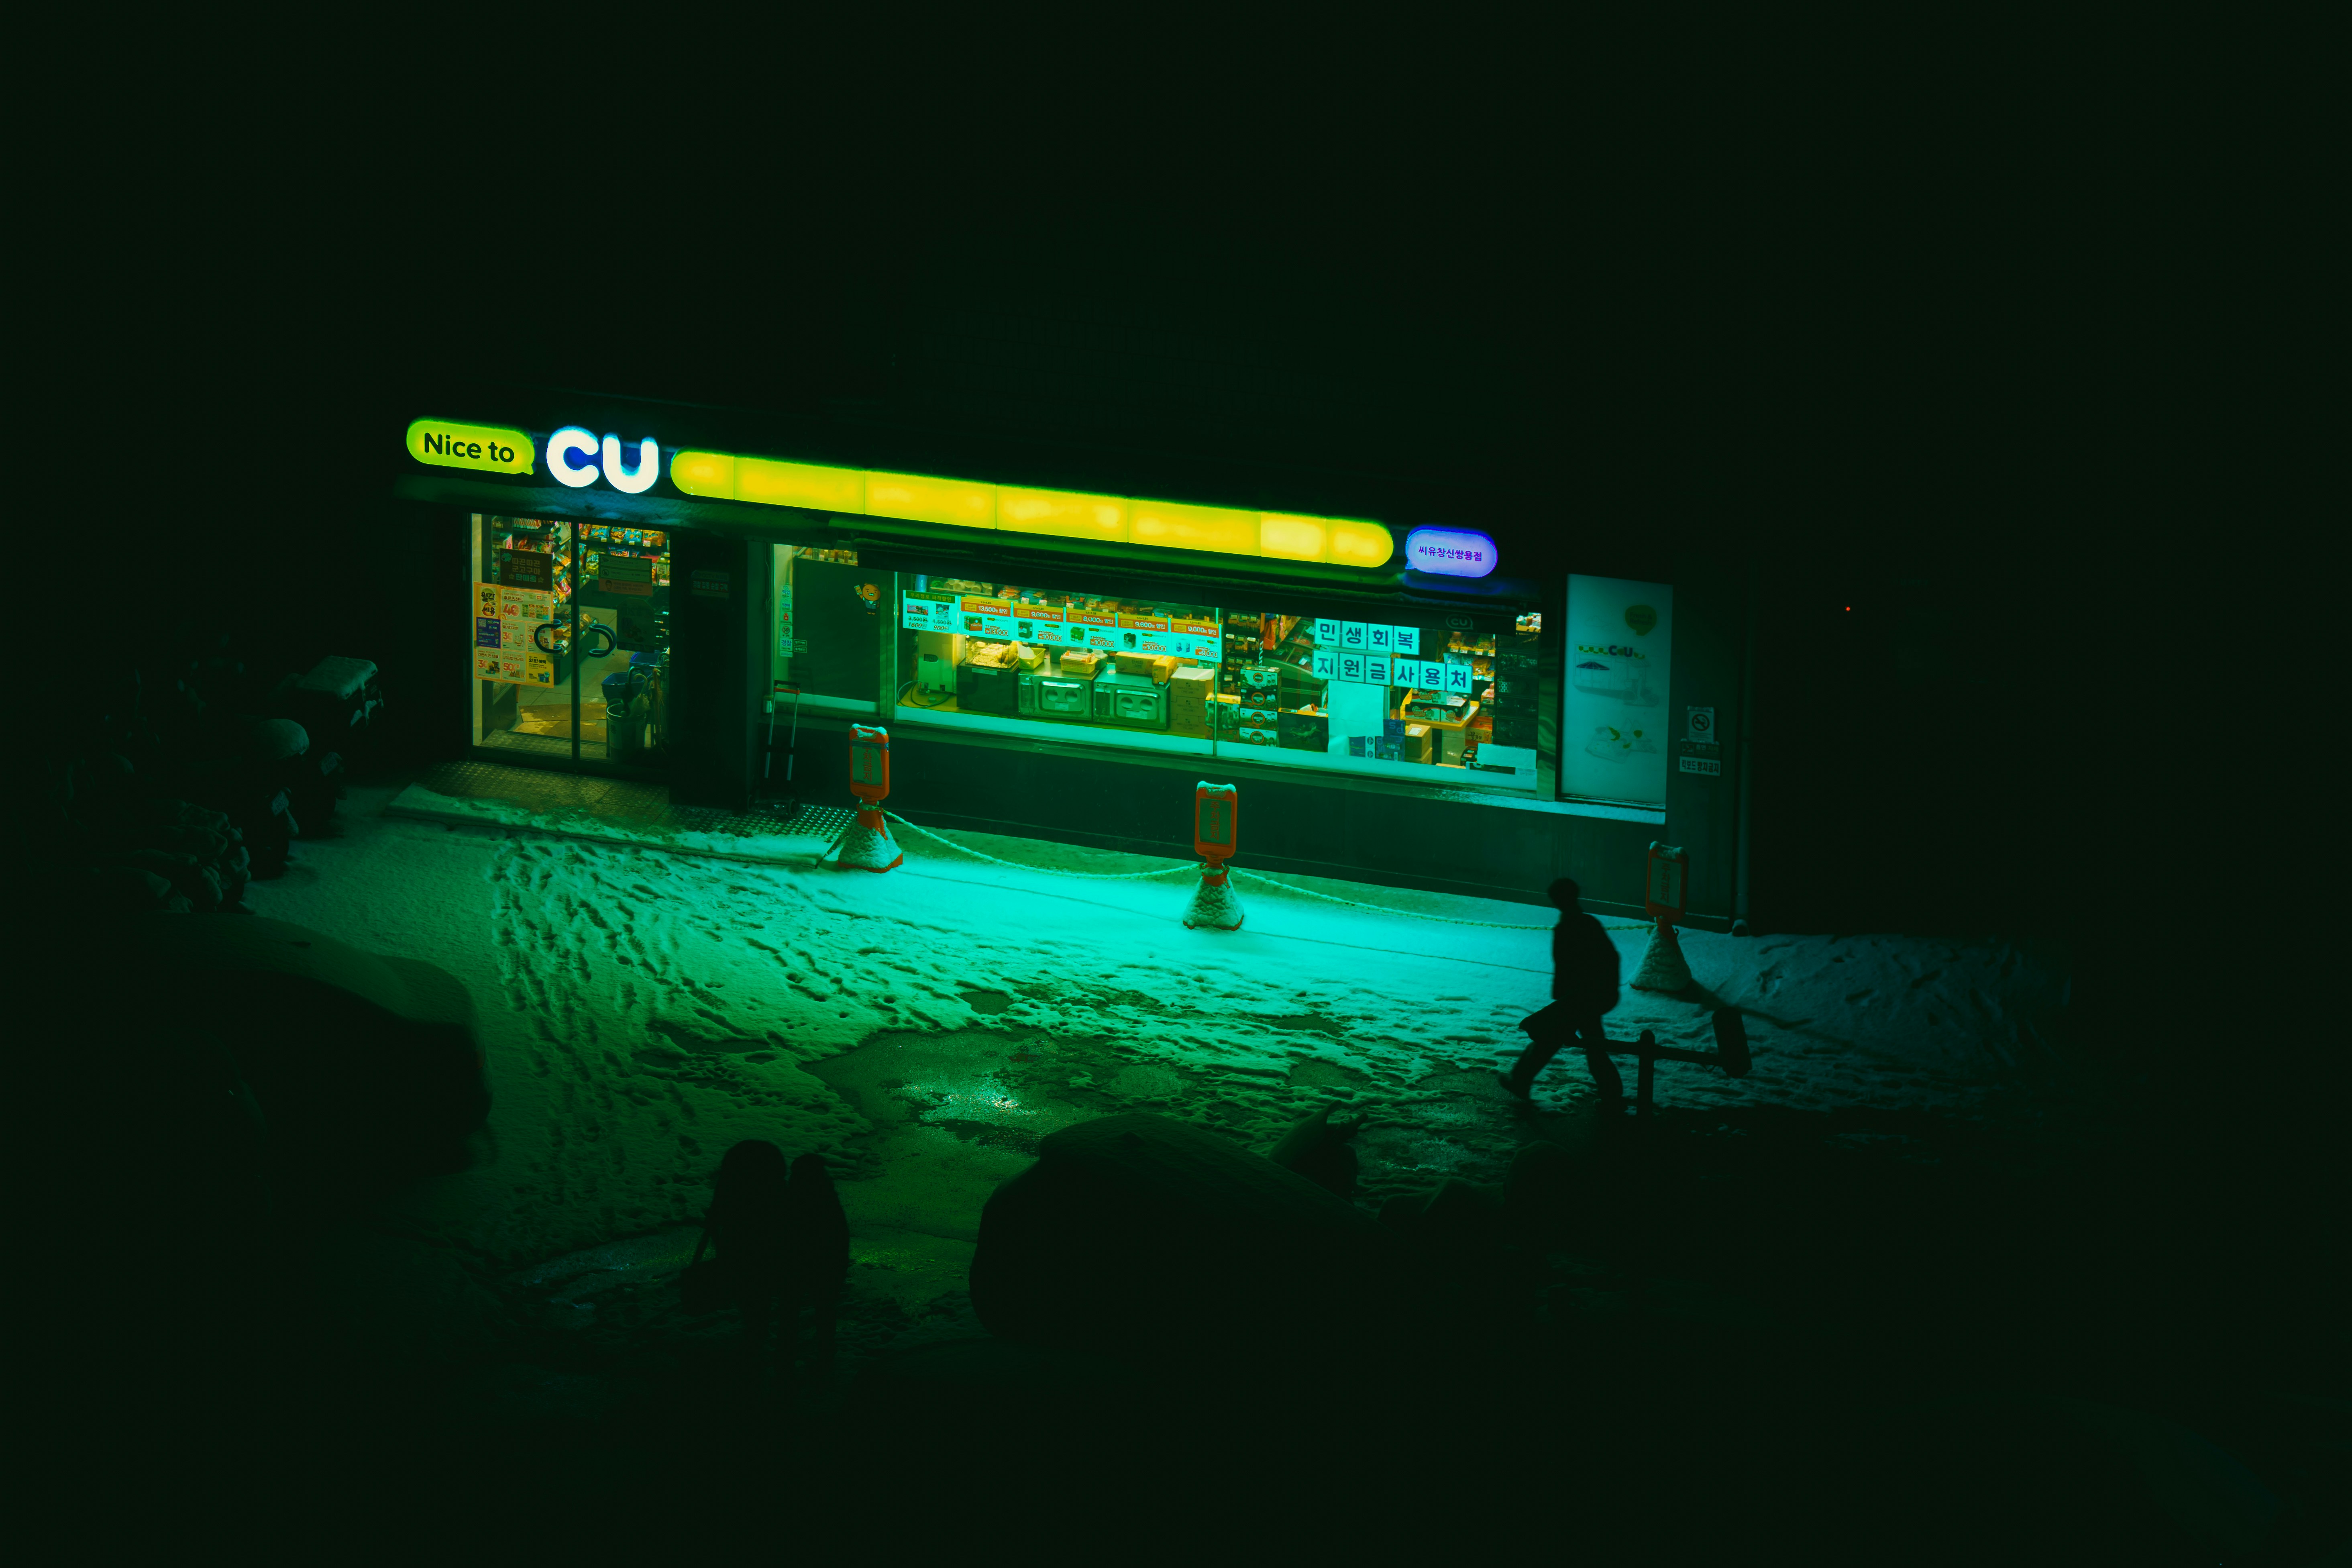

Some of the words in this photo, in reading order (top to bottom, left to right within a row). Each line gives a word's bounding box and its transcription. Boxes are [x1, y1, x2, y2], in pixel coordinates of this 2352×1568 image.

[424, 432, 482, 459] Nice
[489, 441, 515, 463] to
[546, 426, 659, 493] CU
[1419, 546, 1482, 562] 씨유창신쌍용점
[512, 565, 540, 575] 군고구마
[516, 574, 536, 583] 판매중
[481, 592, 495, 602] 월간
[1319, 623, 1414, 649] 민생회복
[1317, 658, 1386, 680] 지원금
[1398, 666, 1466, 688] 사용처
[1210, 801, 1221, 841] 주차금지
[1660, 863, 1671, 903] 주차금지
